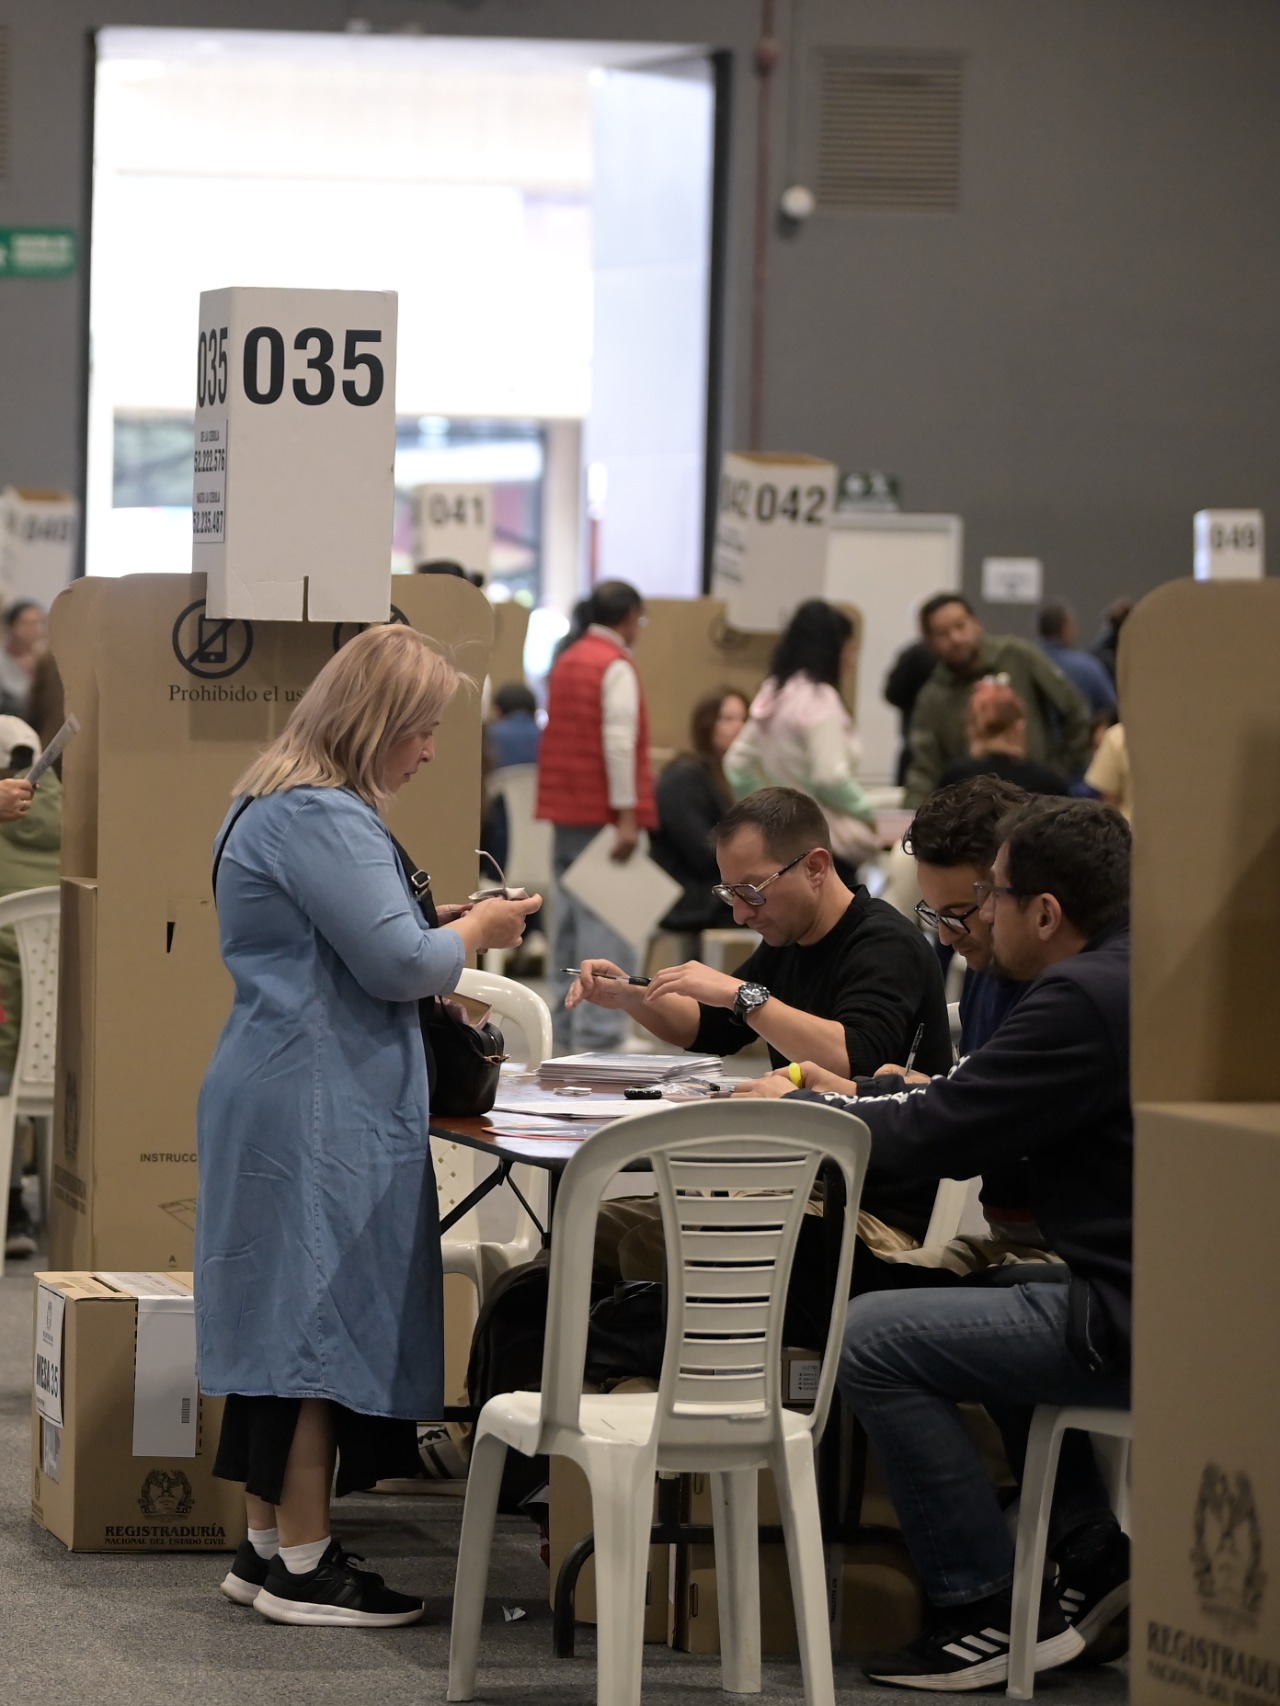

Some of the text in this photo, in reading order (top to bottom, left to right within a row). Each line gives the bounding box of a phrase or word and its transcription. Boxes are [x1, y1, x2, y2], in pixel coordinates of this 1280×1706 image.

[197, 327, 228, 408] 035
[243, 326, 384, 406] 035
[428, 493, 484, 528] 041
[755, 482, 827, 526] 042
[168, 684, 304, 702] Prohibido el us
[139, 1152, 198, 1163] INSTRUCC
[51, 1363, 59, 1398] 35
[105, 1522, 226, 1537] REGISTRADURÍA
[1147, 1621, 1280, 1697] REGISTRADU
